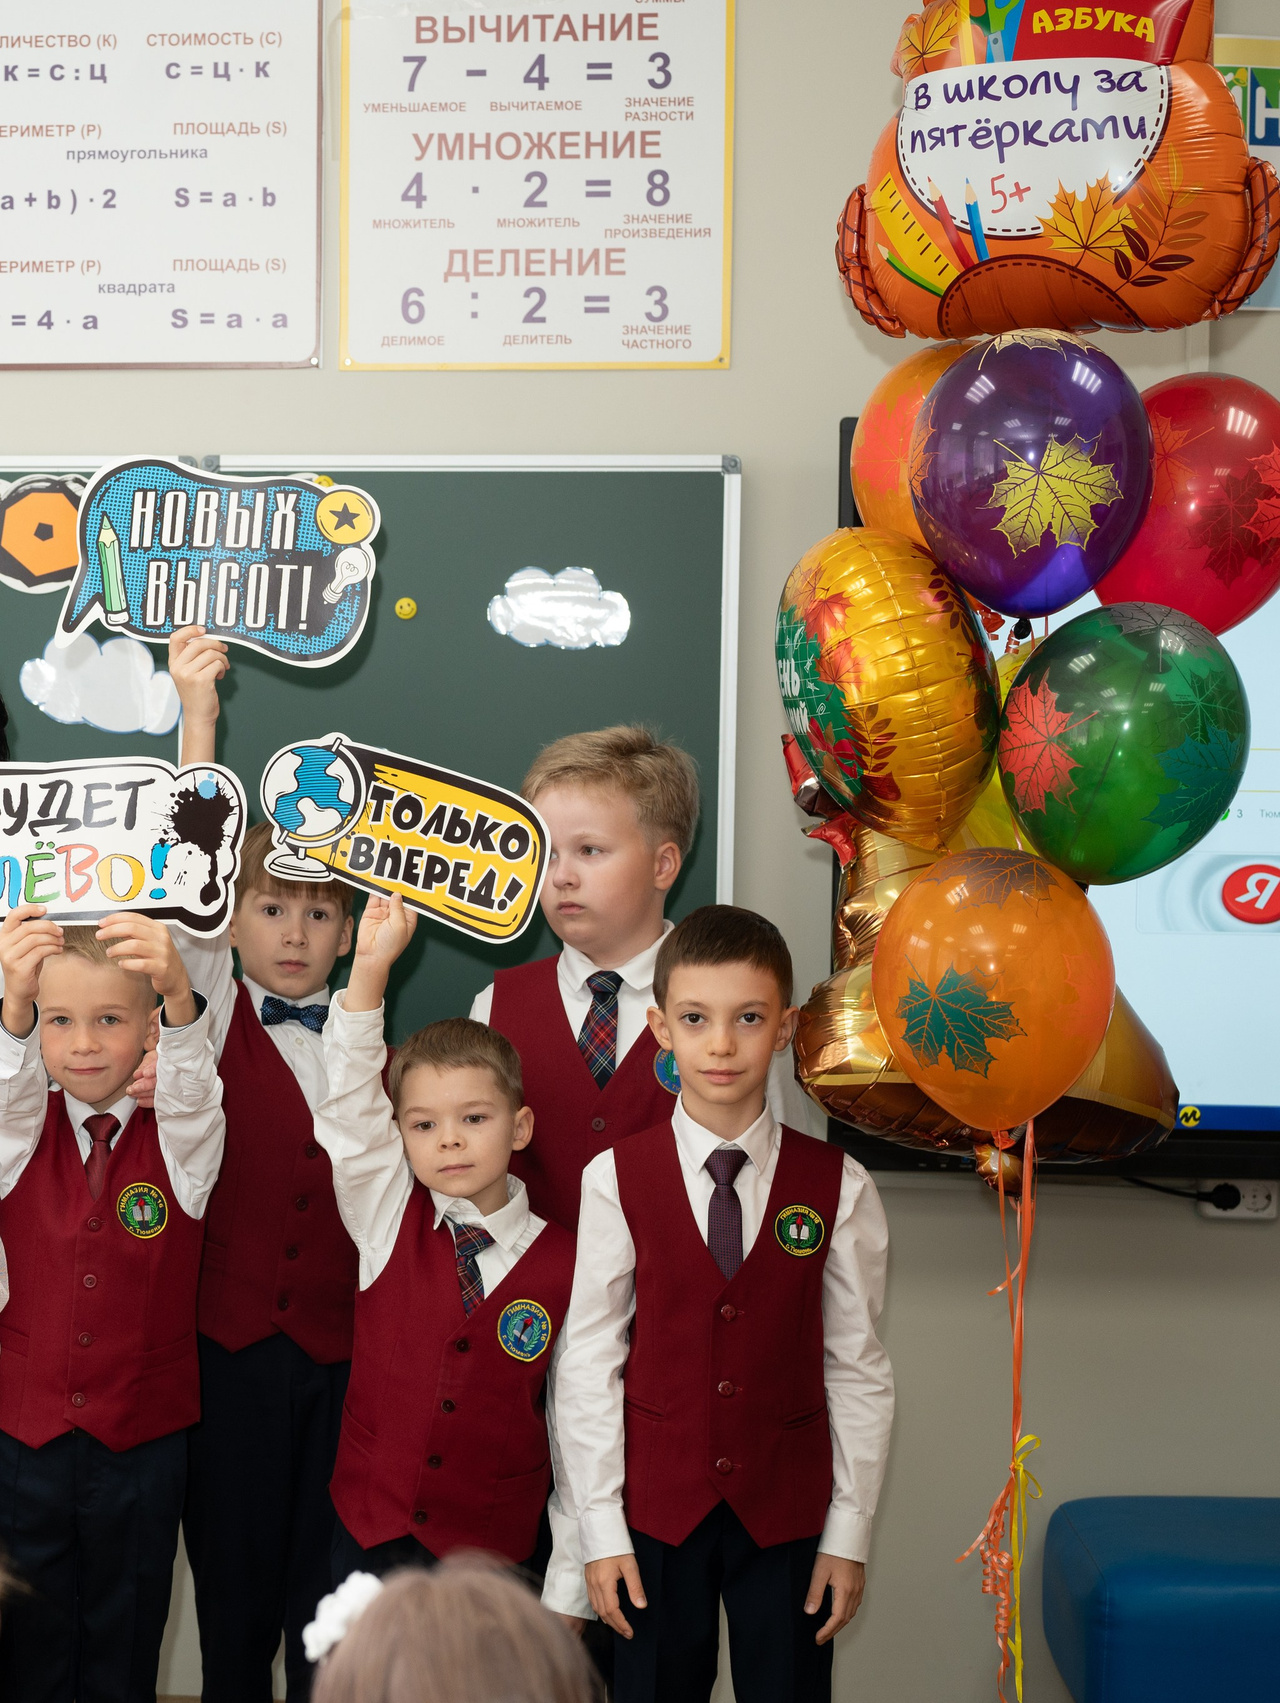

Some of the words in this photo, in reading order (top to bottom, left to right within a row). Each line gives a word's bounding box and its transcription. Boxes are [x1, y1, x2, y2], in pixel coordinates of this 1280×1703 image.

[415, 12, 660, 45] ВЫЧИТАНИЕ
[1031, 6, 1156, 44] АЗБУКА
[96, 34, 118, 49] (К)
[146, 32, 255, 47] СТОИМОСТЬ
[259, 32, 283, 47] (С)
[402, 55, 428, 93] 7
[522, 53, 550, 92] 4
[647, 51, 673, 90] 3
[1093, 69, 1148, 93] за
[363, 102, 466, 112] УМЕНЬШАЕМОЕ
[489, 101, 583, 111] ВЫЧИТАЕМОЕ
[624, 97, 695, 107] ЗНАЧЕНИЕ
[624, 111, 694, 121] РАЗНОСТИ
[173, 122, 261, 136] ПЛОЩАДЬ
[265, 122, 288, 136] (S)
[411, 129, 662, 162] УМНОЖЕНИЕ
[910, 115, 1147, 164] пятёрками
[66, 149, 208, 163] прямоугольника
[400, 171, 428, 209] 4
[522, 170, 548, 209] 2
[645, 168, 671, 207] 8
[990, 173, 1032, 214] 5+
[372, 219, 455, 228] МНОЖИТЕЛЬ
[496, 218, 581, 227] МНОЖИТЕЛЬ
[623, 214, 693, 224] ЗНАЧЕНИЕ
[604, 228, 712, 239] ПРОИЗВЕДЕНИЯ
[172, 259, 260, 273] ПЛОЩАДЬ
[265, 259, 287, 273] (S)
[443, 247, 627, 284] ДЕЛЕНИЕ
[98, 283, 175, 296] квадрата
[401, 287, 426, 325] 6
[521, 286, 547, 324] 2
[644, 284, 670, 323] 3
[622, 325, 691, 335] ЗНАЧЕНИЕ
[381, 336, 444, 347] ДЕЛИМОЕ
[502, 335, 573, 345] ДЕЛИТЕЛЬ
[621, 339, 692, 348] ЧАСТНОГО
[130, 487, 299, 550] НОВЫХ
[145, 561, 313, 631] ВЫСОТ!
[369, 787, 531, 862] ТОЛЬКО
[348, 832, 526, 914] ВПЕРЕД!
[1234, 872, 1280, 910] Я
[120, 1186, 149, 1213] ГИМНАЗИЯ
[506, 1303, 544, 1319] ГИМНАЗИЯ
